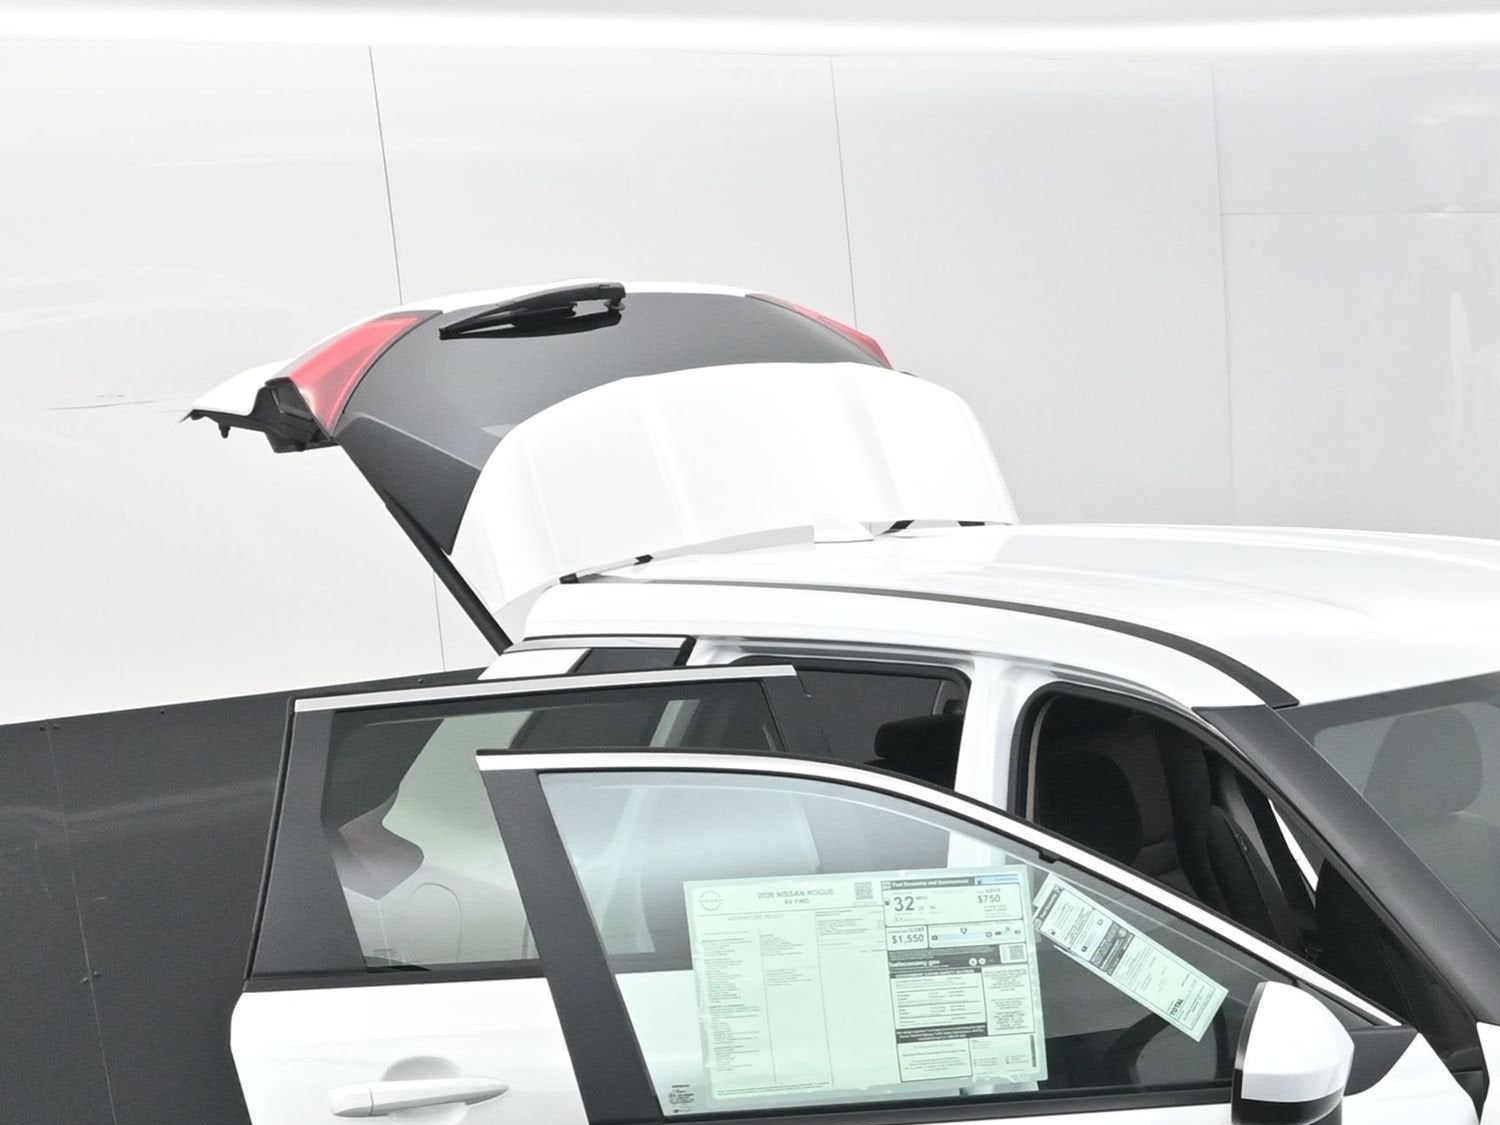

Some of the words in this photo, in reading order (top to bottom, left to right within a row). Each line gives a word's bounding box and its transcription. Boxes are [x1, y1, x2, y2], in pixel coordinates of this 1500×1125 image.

[893, 896, 915, 912] 32
[977, 894, 1001, 904] $750
[892, 933, 924, 945] $1,550
